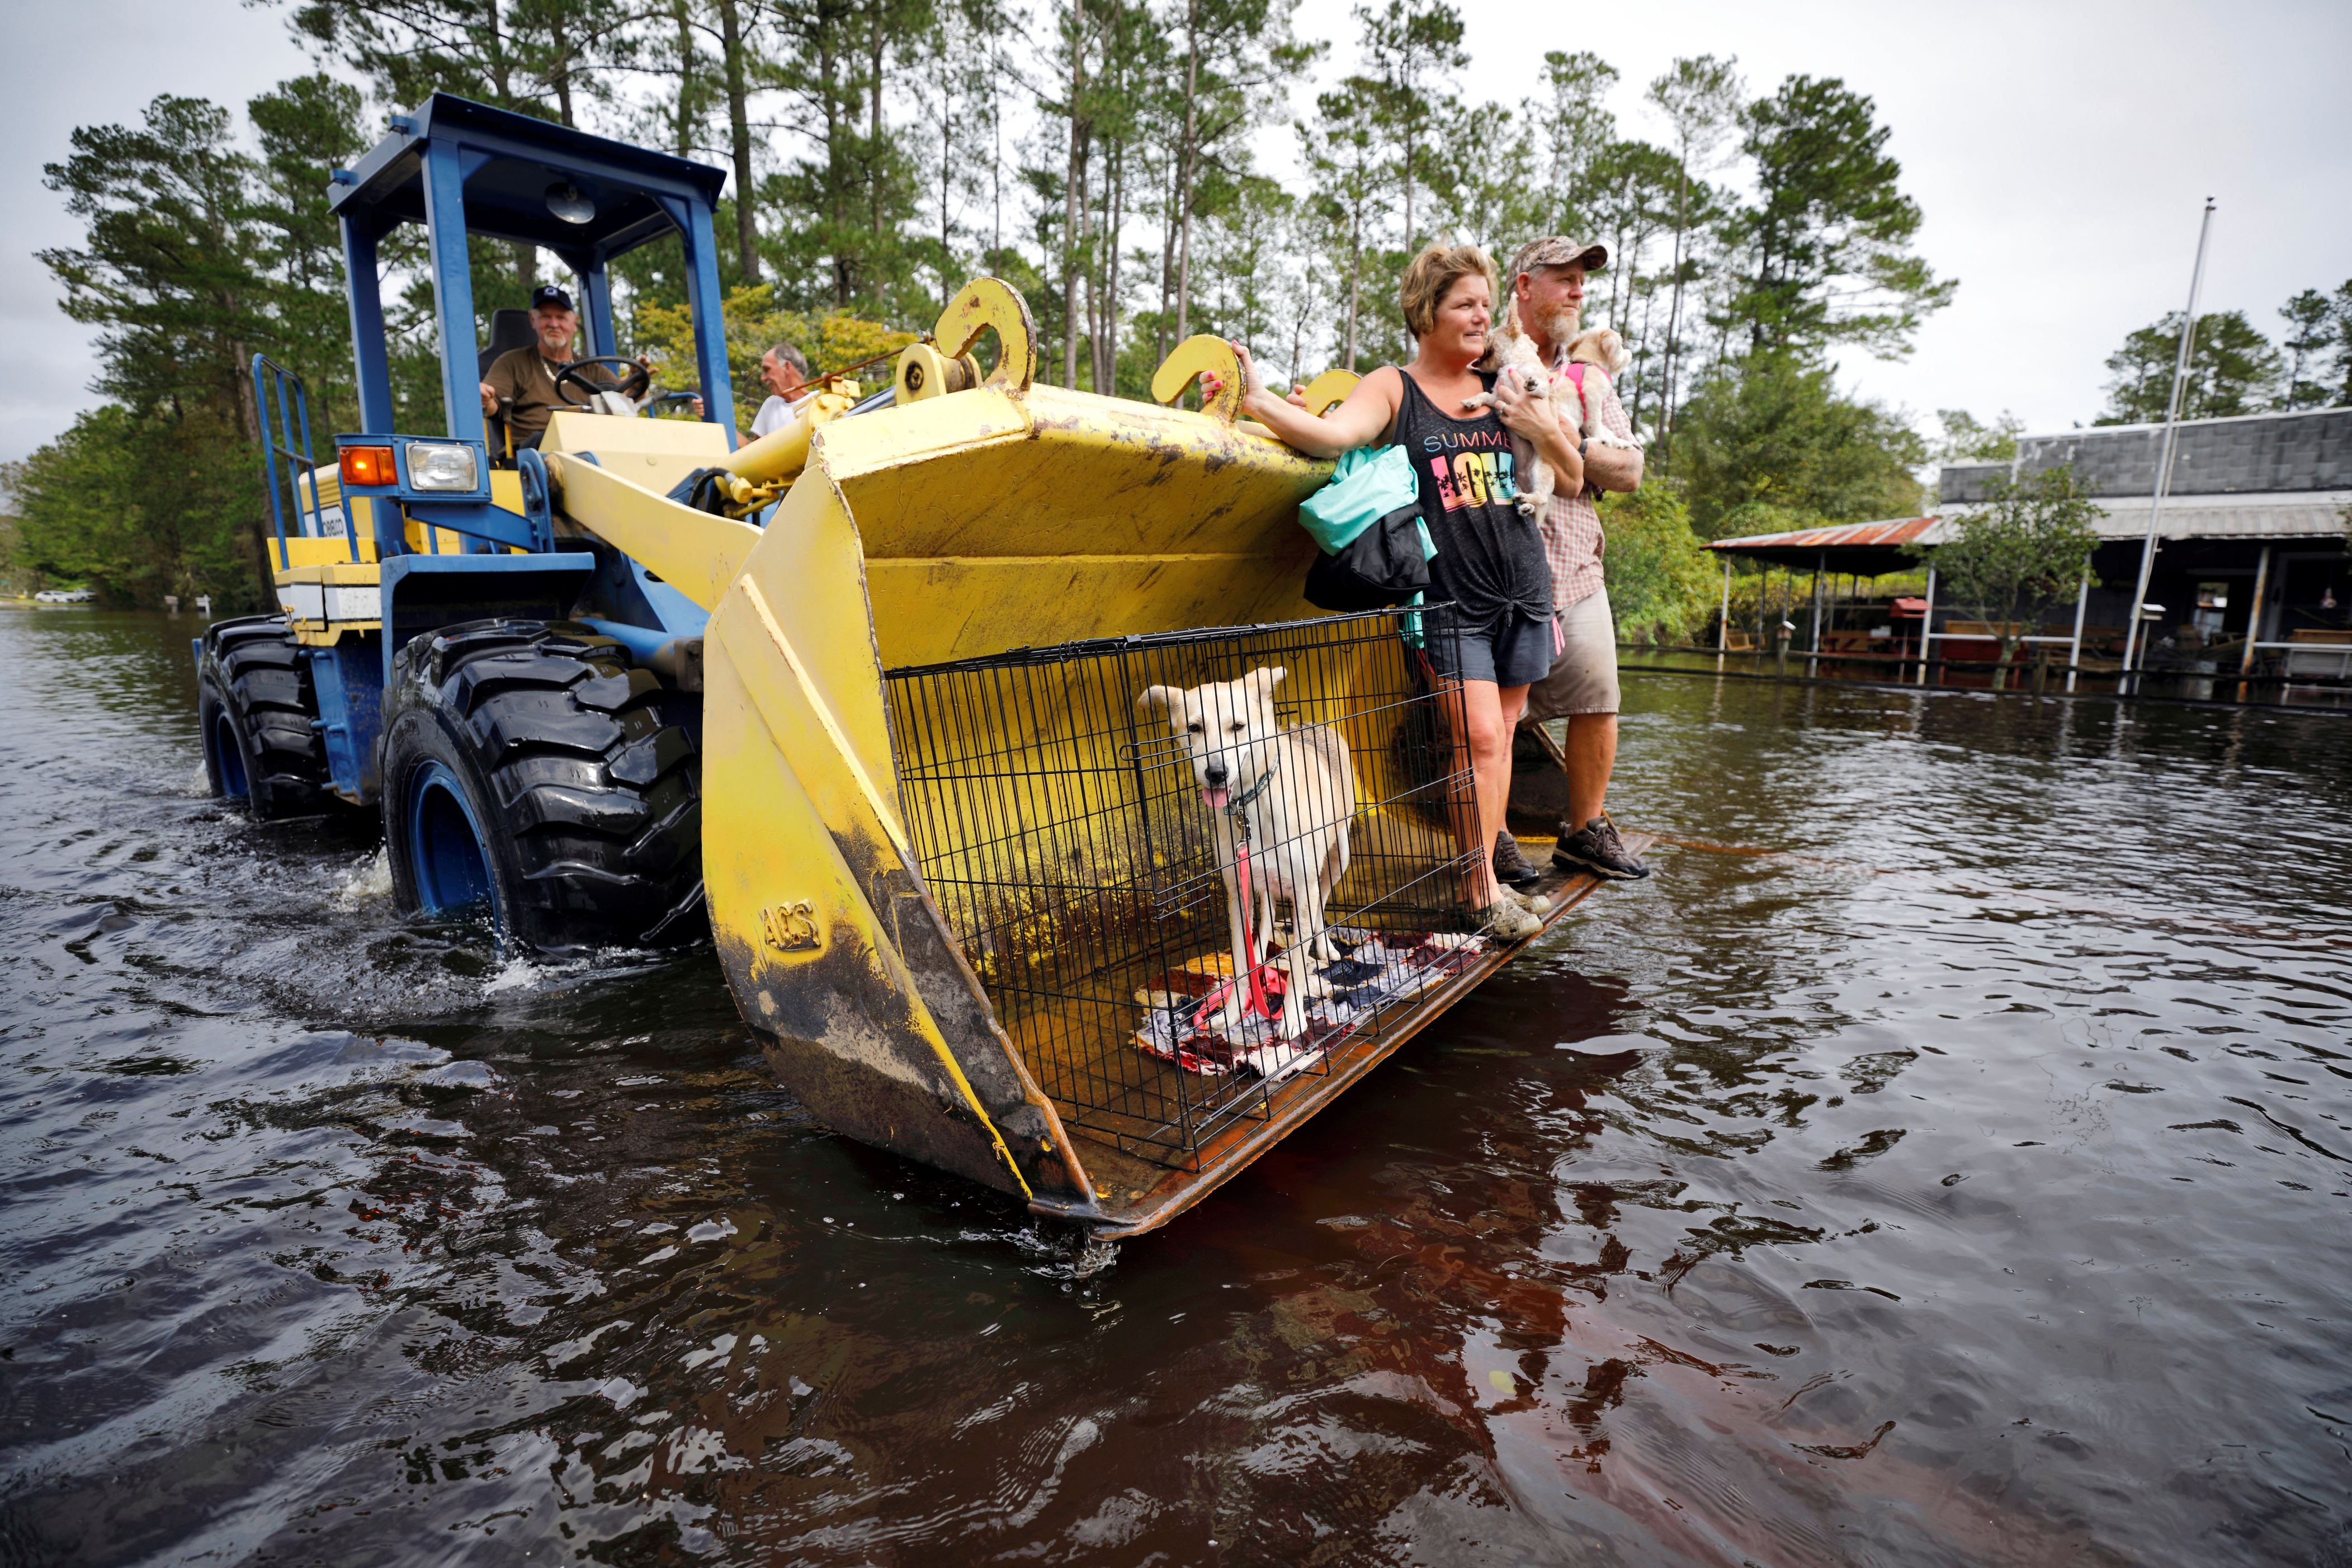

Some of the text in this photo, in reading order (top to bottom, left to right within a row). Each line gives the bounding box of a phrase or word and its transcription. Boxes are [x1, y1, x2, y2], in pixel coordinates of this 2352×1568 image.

[1424, 431, 1512, 453] SUMME
[1430, 451, 1516, 513] LOV
[764, 899, 821, 951] ACS
